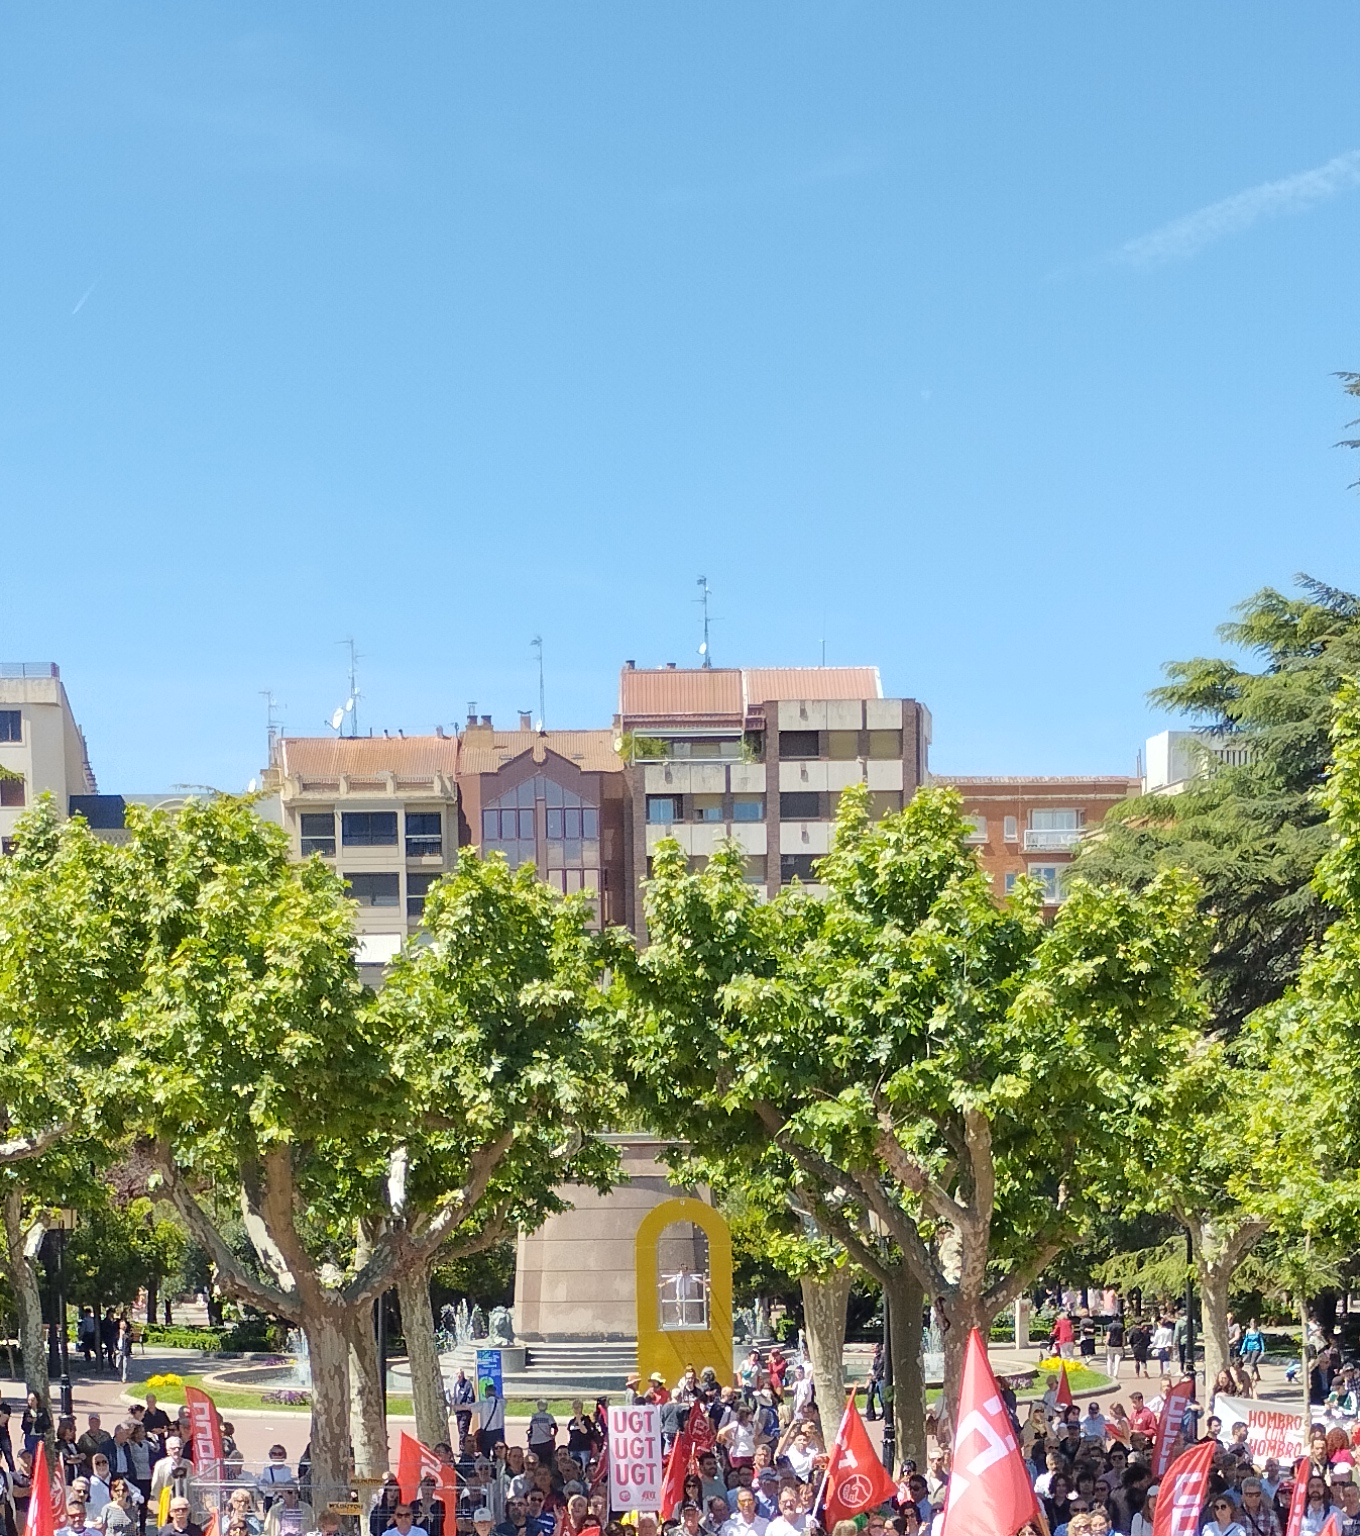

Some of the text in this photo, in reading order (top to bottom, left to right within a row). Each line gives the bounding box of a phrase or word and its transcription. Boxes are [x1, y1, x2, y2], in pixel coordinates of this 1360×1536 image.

[613, 1411, 655, 1433] UGT
[1248, 1411, 1303, 1430] HOMBRO
[614, 1436, 656, 1459] UGT
[1249, 1440, 1302, 1457] HOMBRO
[616, 1463, 657, 1486] UGT
